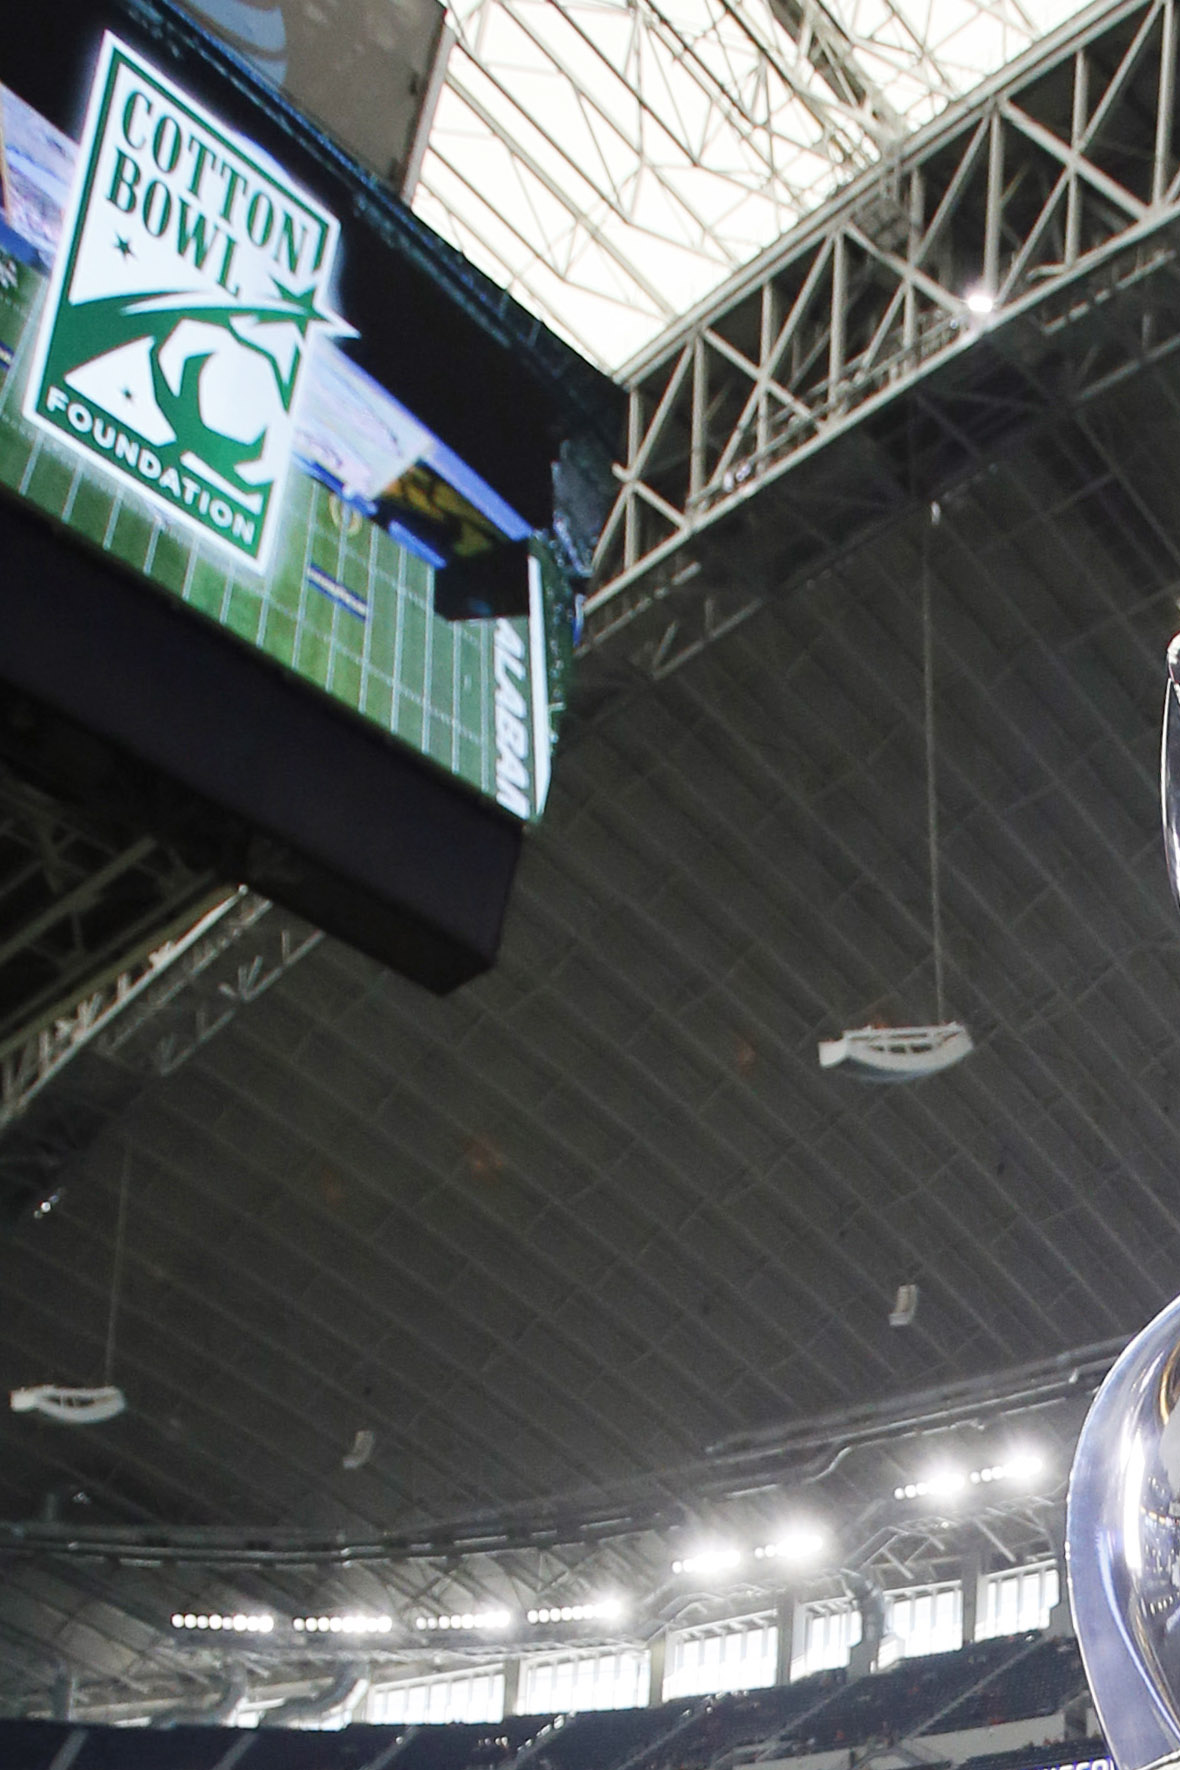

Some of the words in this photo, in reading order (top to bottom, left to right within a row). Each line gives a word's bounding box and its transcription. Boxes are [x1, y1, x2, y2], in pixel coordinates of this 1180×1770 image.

[108, 147, 242, 297] BOWL
[120, 88, 313, 271] COTTON
[45, 388, 257, 546] FOUNDATION
